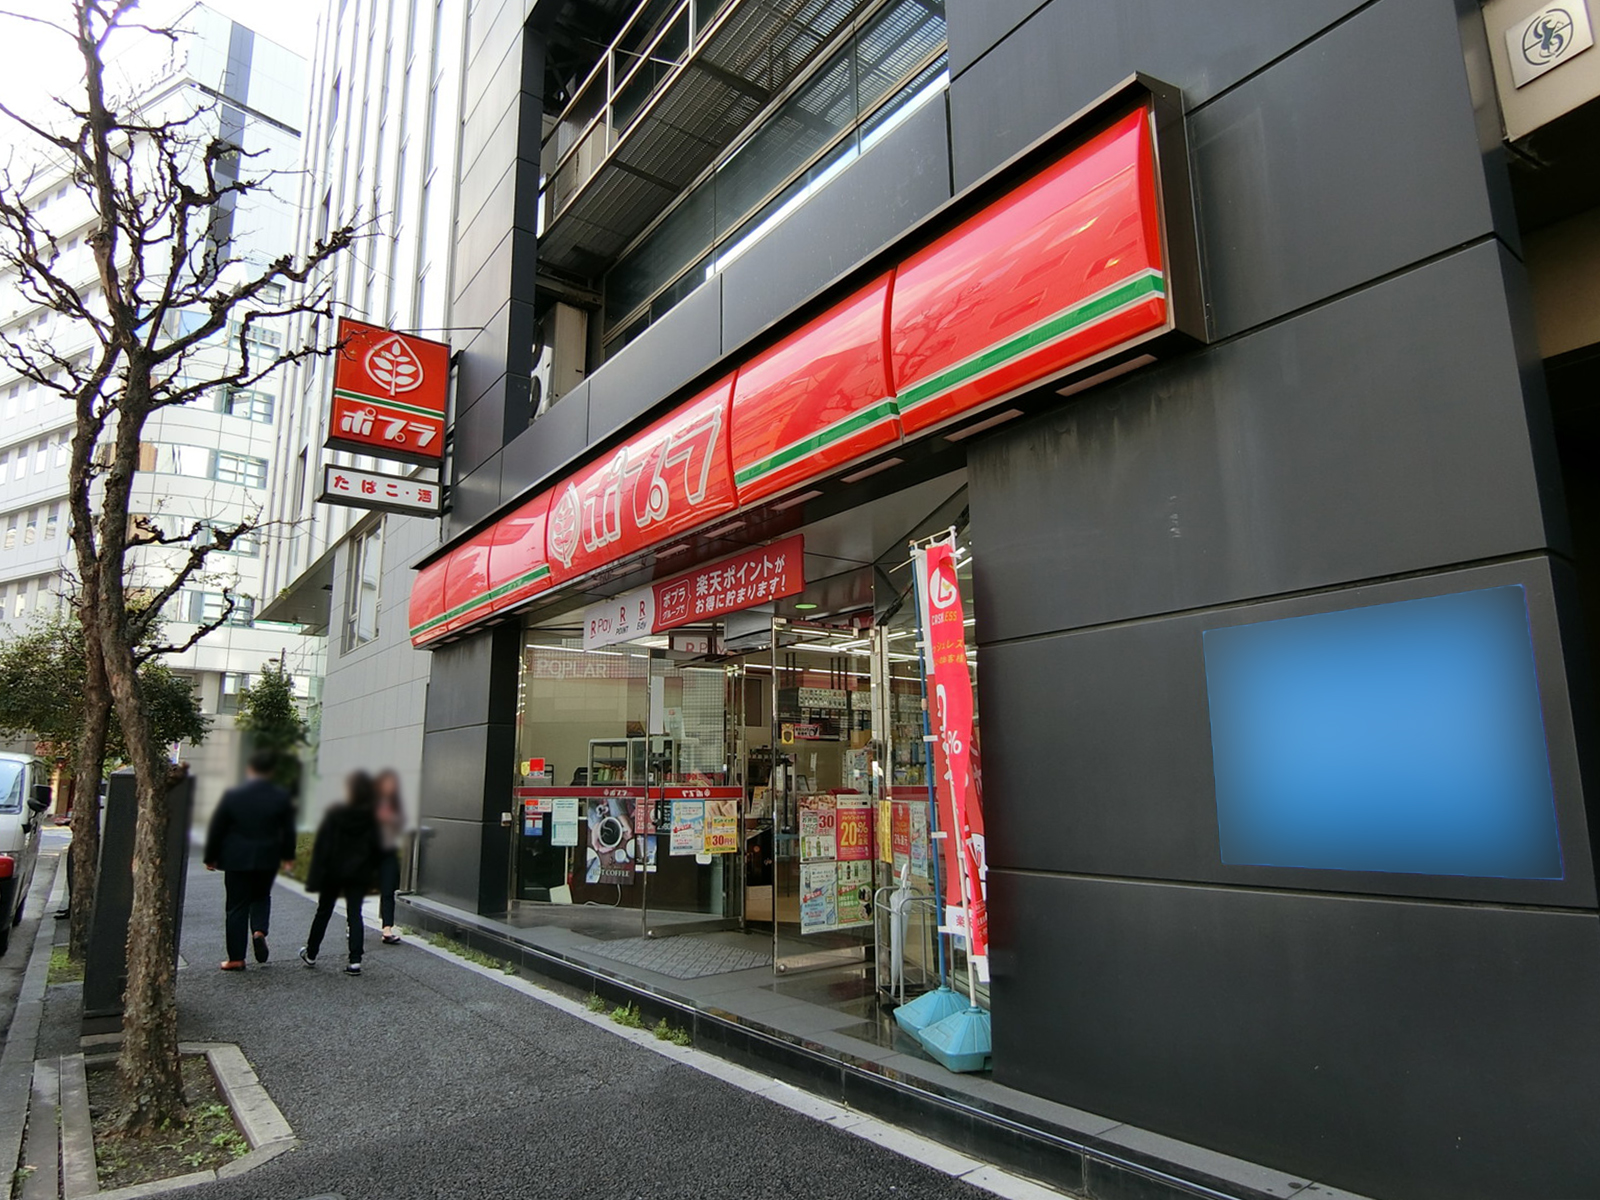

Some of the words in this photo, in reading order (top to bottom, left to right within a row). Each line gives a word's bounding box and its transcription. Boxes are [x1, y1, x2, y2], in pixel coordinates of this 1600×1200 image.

[341, 407, 437, 447] ポプラ
[334, 475, 432, 503] たばこ・酒
[582, 404, 723, 552] ポプラ
[696, 554, 786, 596] 楽天ポイントが
[663, 587, 686, 608] ポプラ
[695, 574, 786, 614] お得に貯まります!
[597, 619, 613, 633] Pay
[662, 604, 685, 620] グループで
